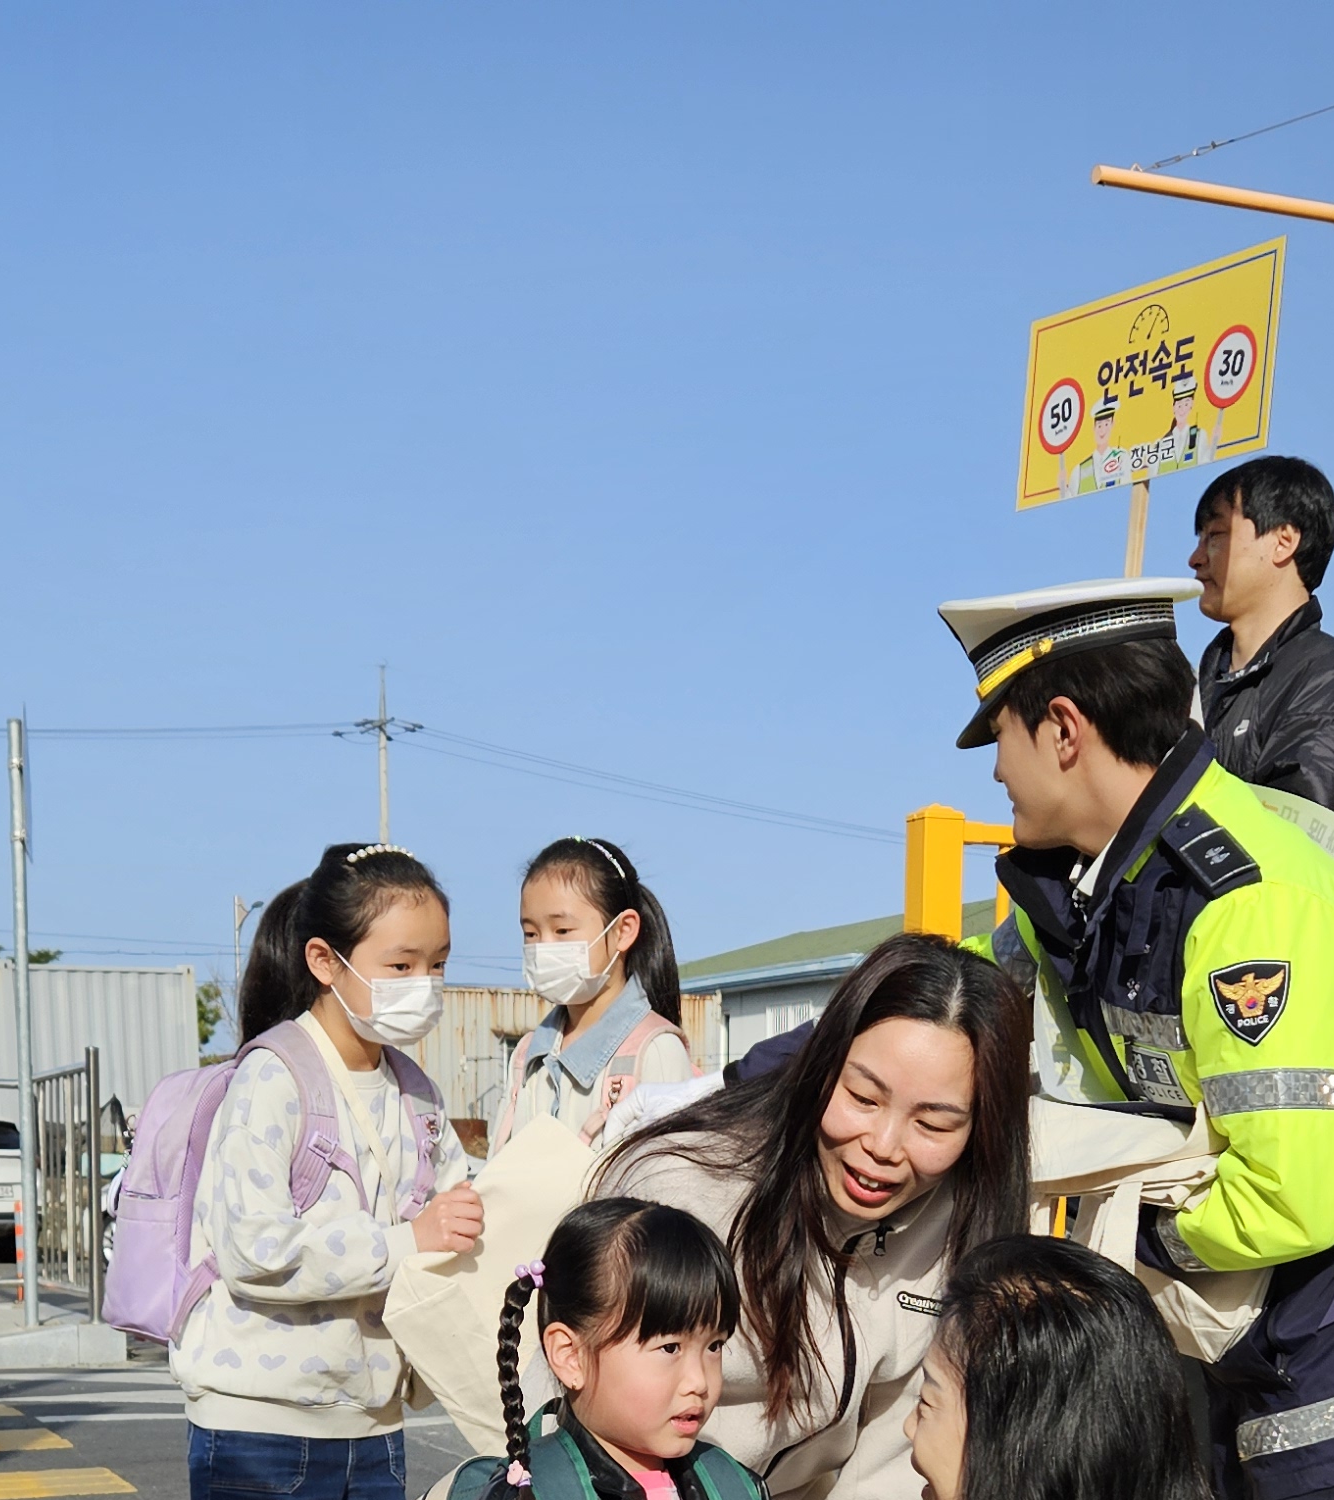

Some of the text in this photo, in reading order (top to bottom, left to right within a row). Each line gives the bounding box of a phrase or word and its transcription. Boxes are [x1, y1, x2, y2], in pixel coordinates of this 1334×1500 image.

[1097, 335, 1195, 406] 안전속도
[1219, 349, 1244, 377] 30
[1050, 398, 1072, 429] 50
[1131, 437, 1175, 469] 창녕군
[1237, 1014, 1270, 1028] POLICE
